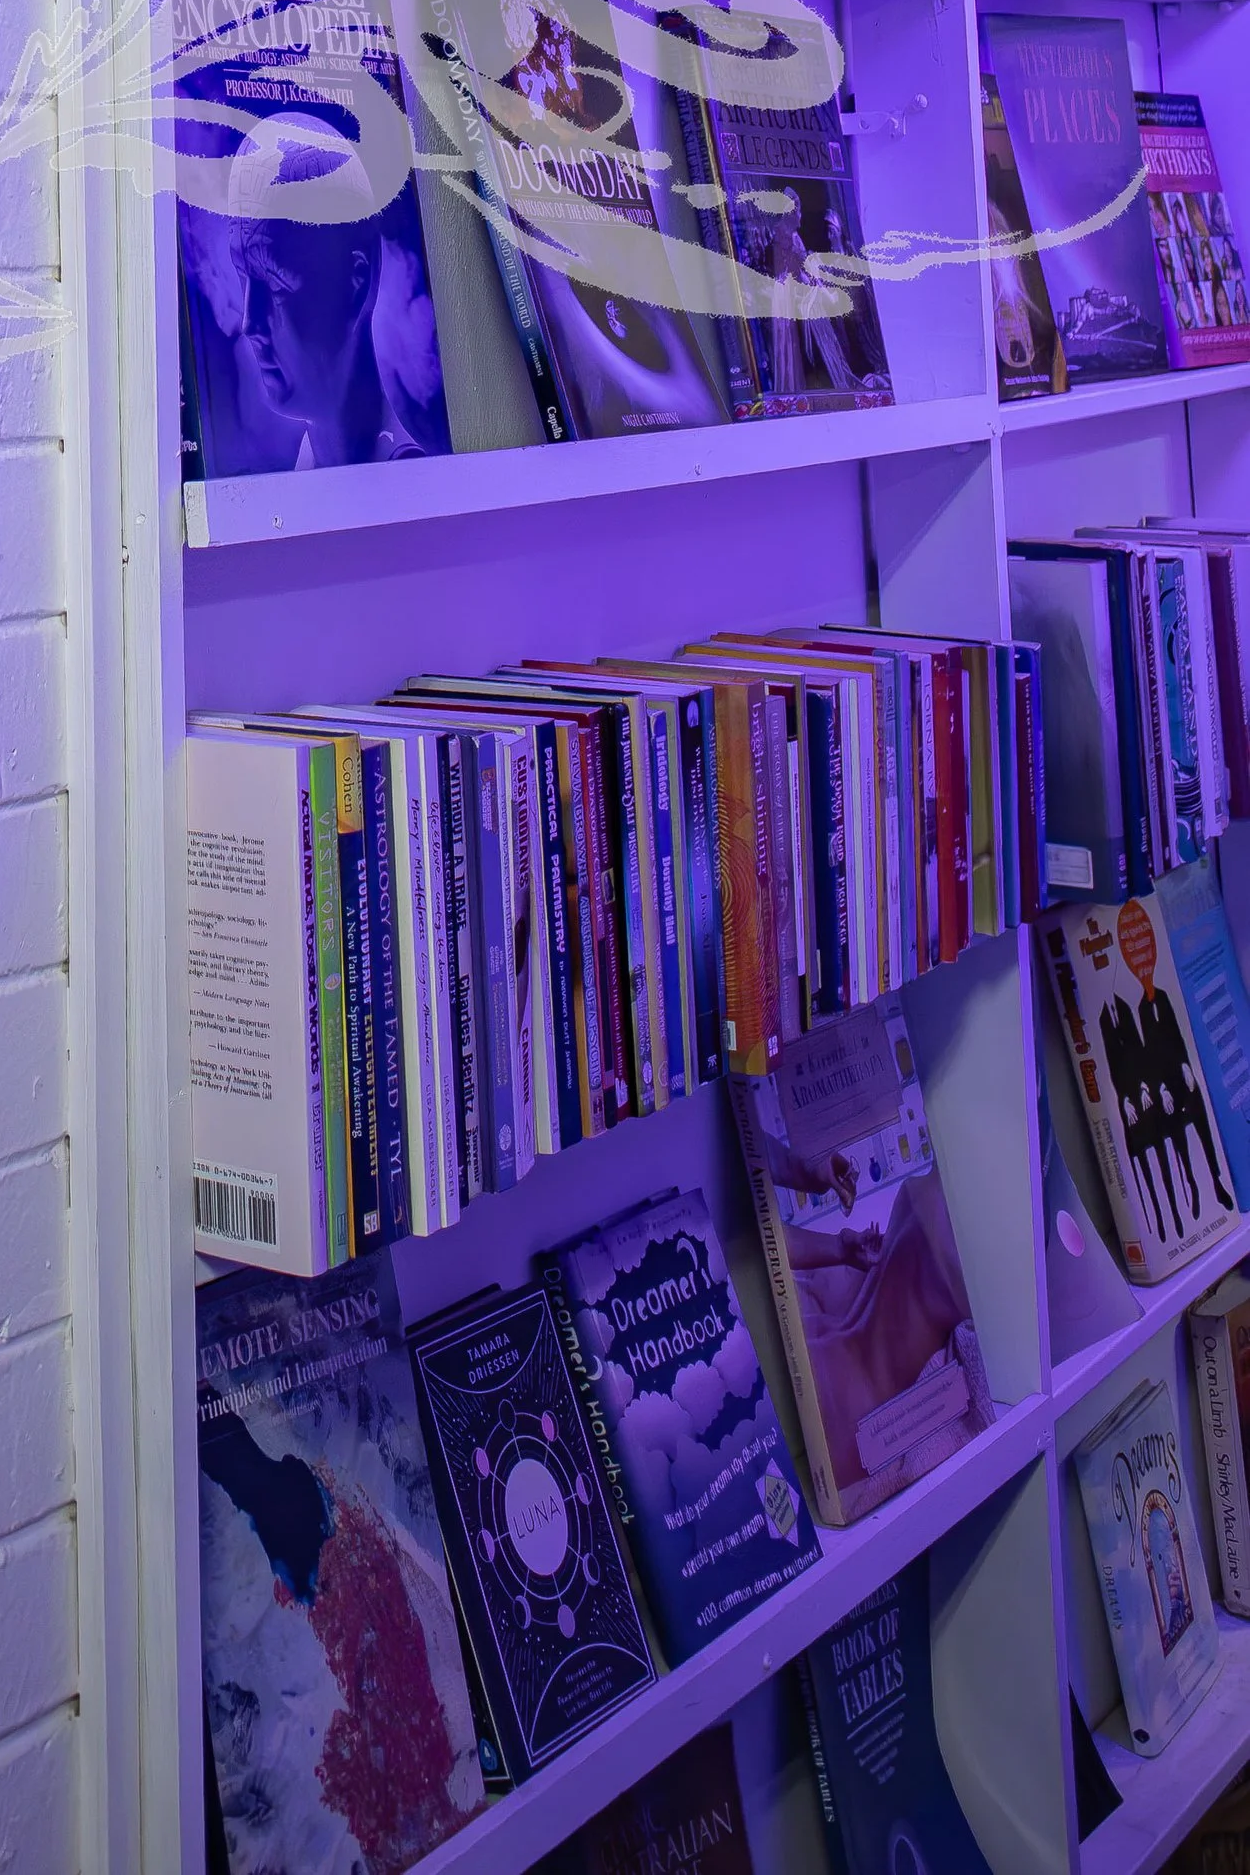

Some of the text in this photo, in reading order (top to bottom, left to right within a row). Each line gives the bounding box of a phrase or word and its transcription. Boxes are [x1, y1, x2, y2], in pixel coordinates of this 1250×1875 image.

[497, 137, 647, 202] DOOMSDAY
[739, 136, 832, 172] LEGENDS
[1024, 89, 1122, 145] PLACES
[341, 754, 354, 814] Cohen
[752, 702, 768, 877] bright shining
[448, 762, 468, 931] WITHOUT A TRACE
[544, 746, 568, 952] PRACTICAL PALMISTRY
[375, 770, 400, 1108] ASTROLOGY OF THE FAMED
[346, 905, 365, 1140] A New Path to Spiritual Awakening
[460, 973, 474, 1117] Charles Berlitz
[467, 1332, 520, 1384] TAMARA DRIESSEN
[625, 1311, 726, 1377] Handbook
[1202, 1335, 1227, 1438] Out on a Limb
[512, 1495, 563, 1540] LUNA
[586, 1396, 635, 1525] Handbook
[1213, 1450, 1241, 1579] Shirley MacLaine
